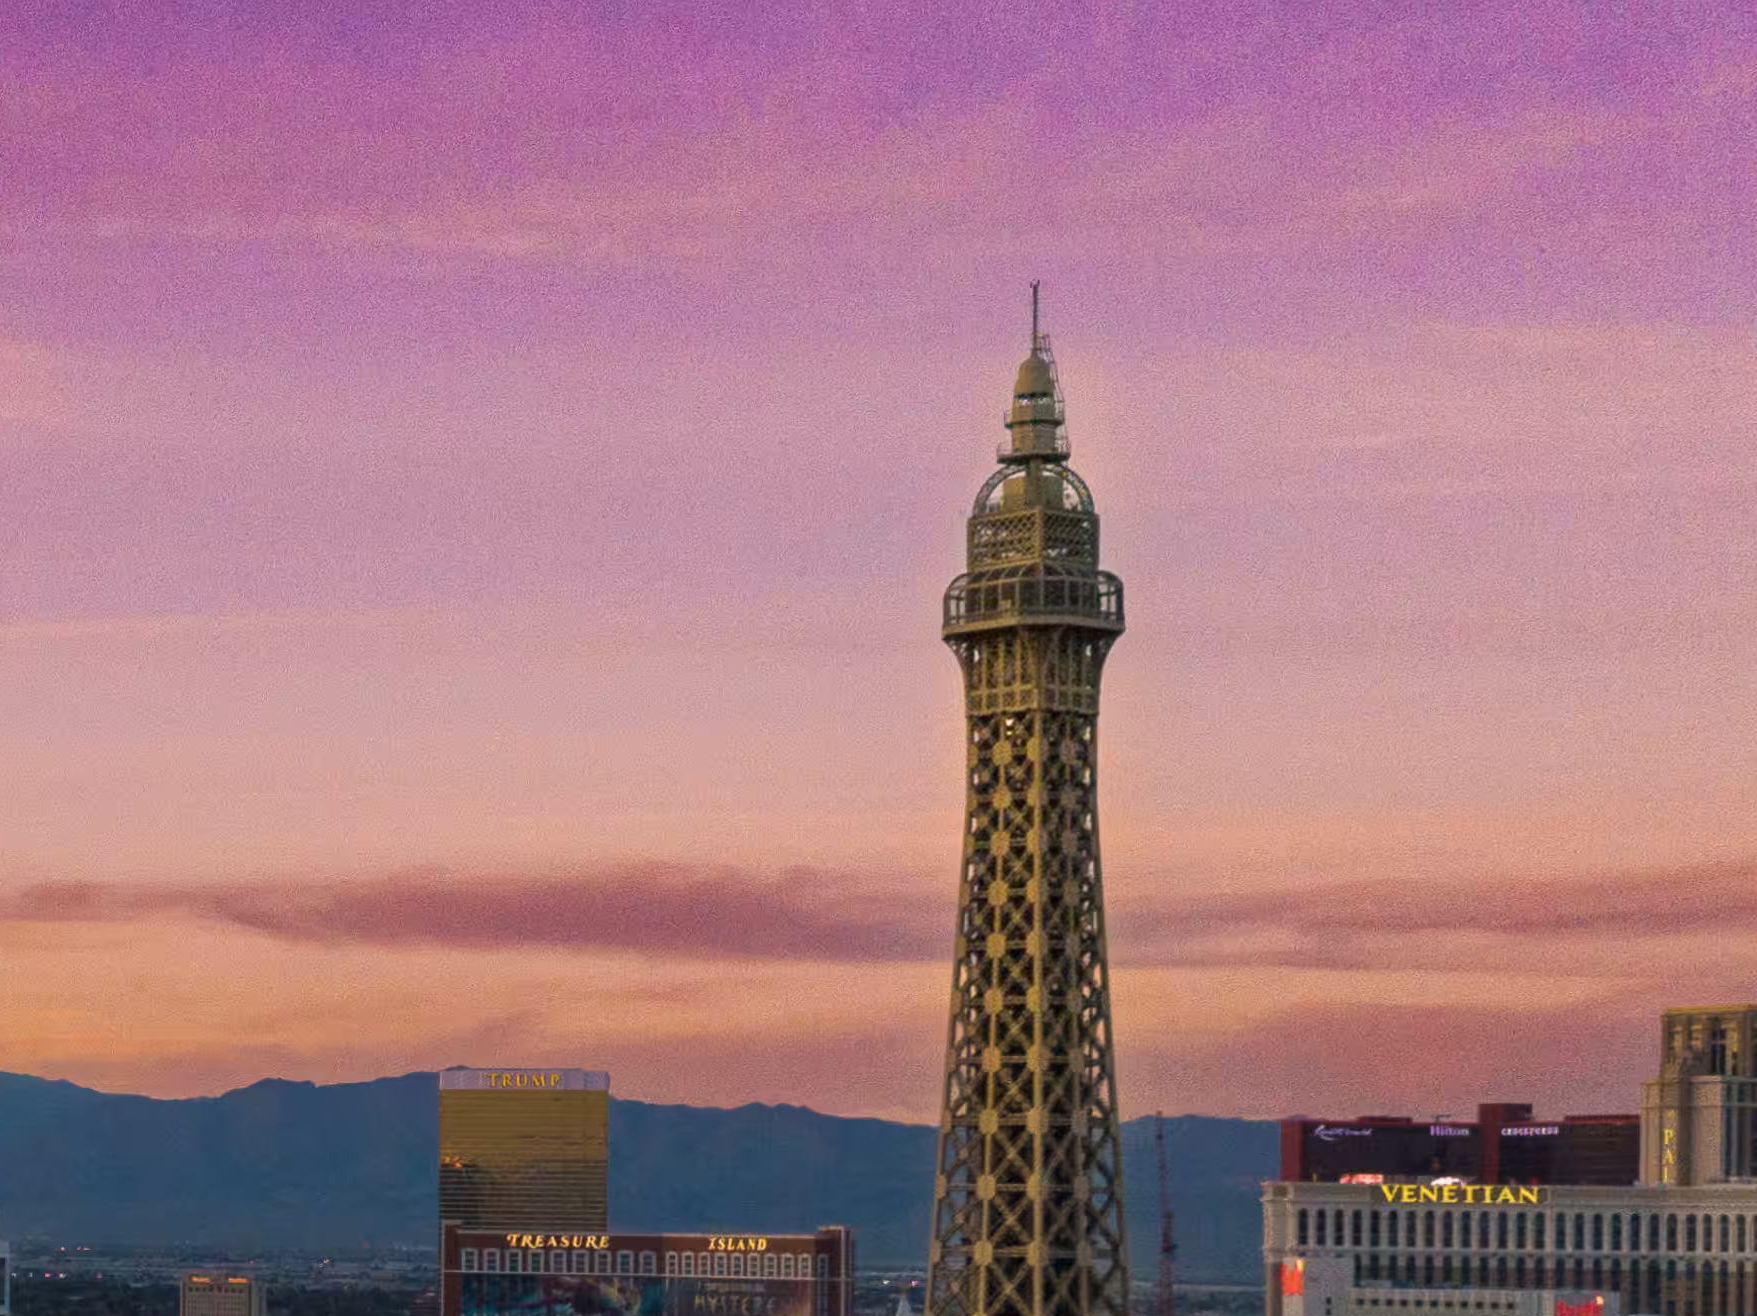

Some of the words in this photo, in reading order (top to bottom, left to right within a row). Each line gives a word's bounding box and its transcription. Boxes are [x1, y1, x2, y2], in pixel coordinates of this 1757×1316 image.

[488, 1072, 561, 1087] TRUMP
[1381, 1184, 1539, 1204] VENETIAN
[506, 1234, 610, 1250] TREASURE
[708, 1236, 768, 1251] ISLAND
